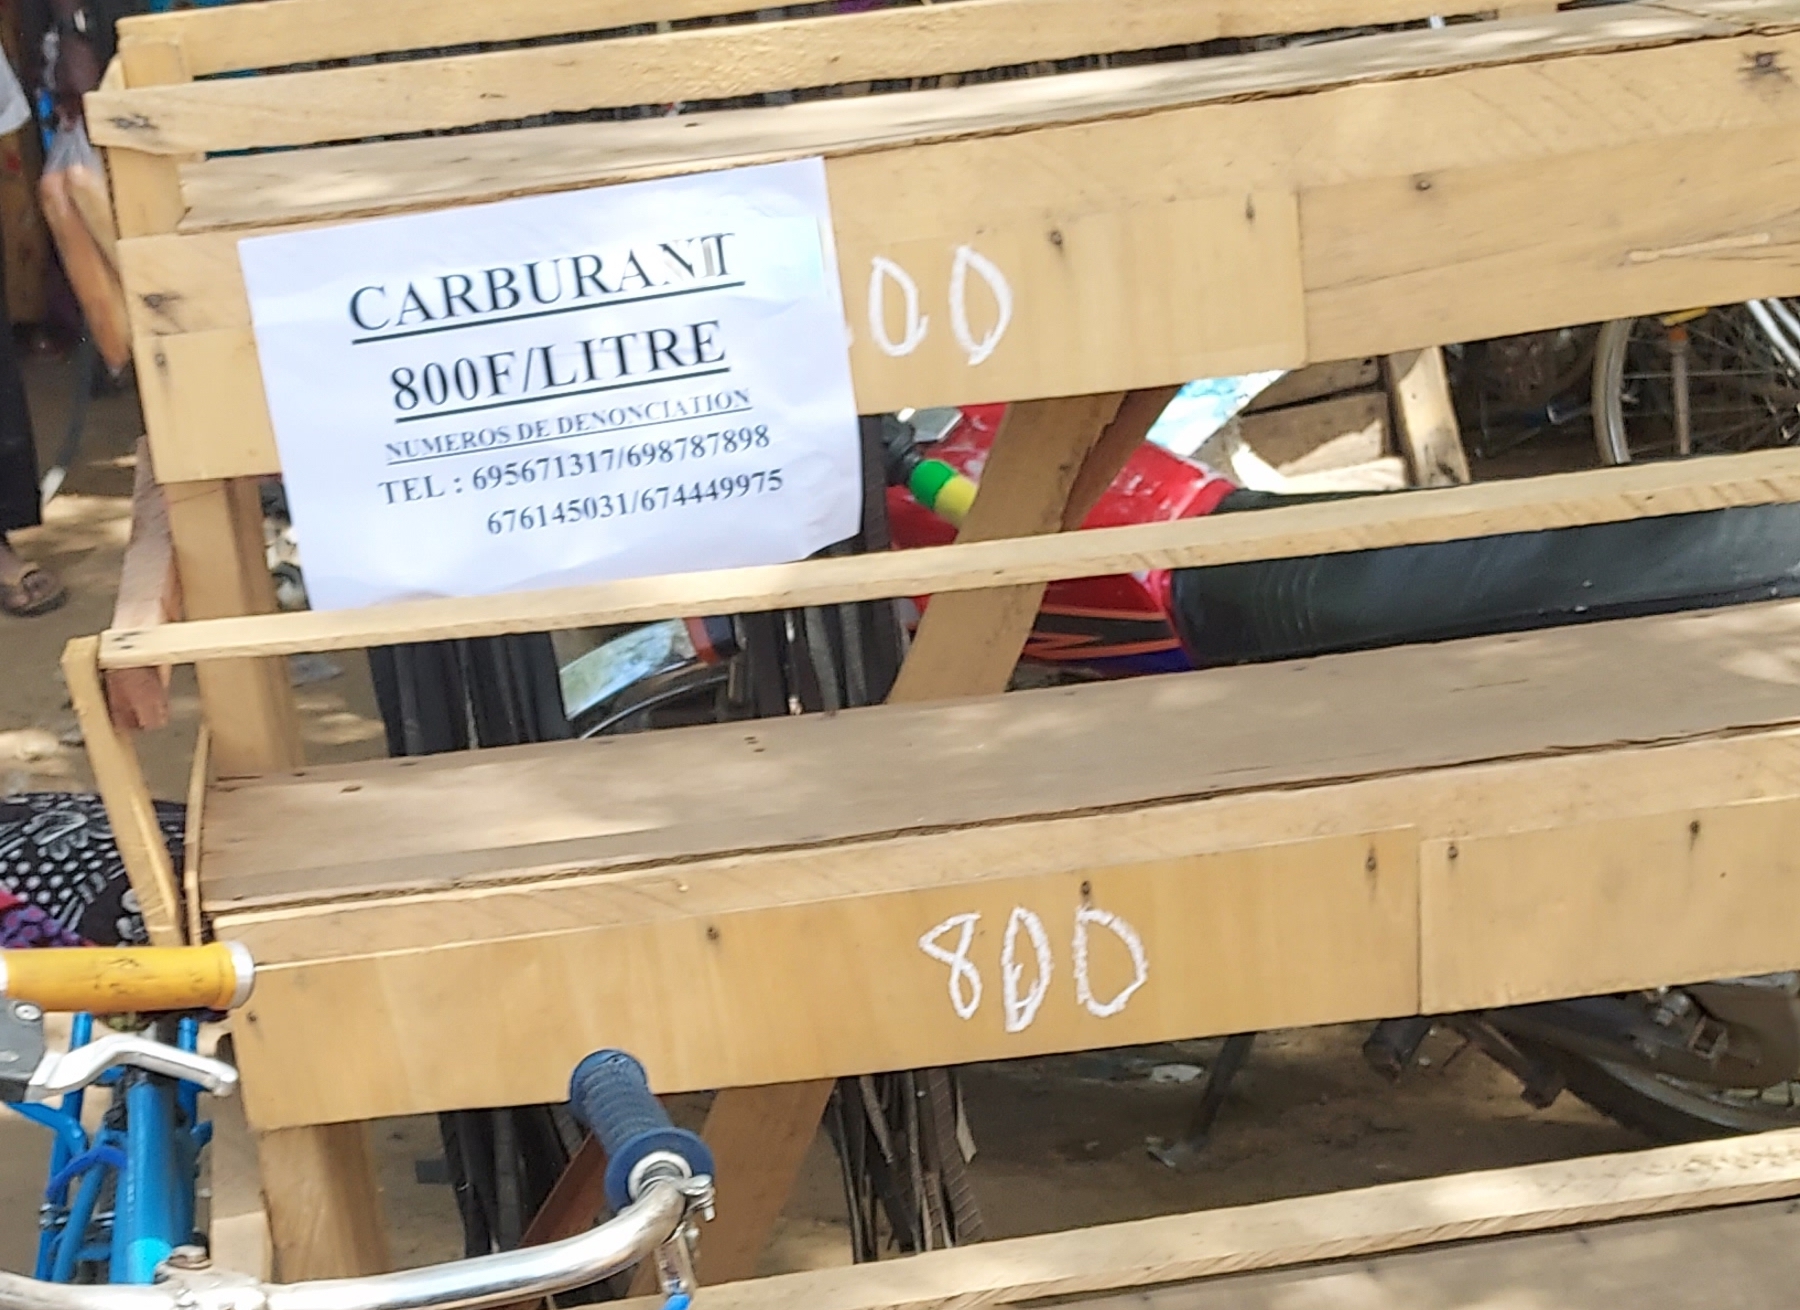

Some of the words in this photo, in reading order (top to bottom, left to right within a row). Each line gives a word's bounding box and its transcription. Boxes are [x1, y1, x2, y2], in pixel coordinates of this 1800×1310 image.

[349, 231, 736, 331] CARBURANT
[846, 244, 1013, 366] 00
[390, 319, 726, 411] 800F/LITRE
[385, 424, 511, 460] NUMEROS
[517, 418, 551, 442] DE
[557, 387, 752, 435] DENONCIATION
[472, 423, 771, 490] 695671317/698787898
[486, 467, 784, 535] 676145031/674449975
[917, 905, 1149, 1033] 800
